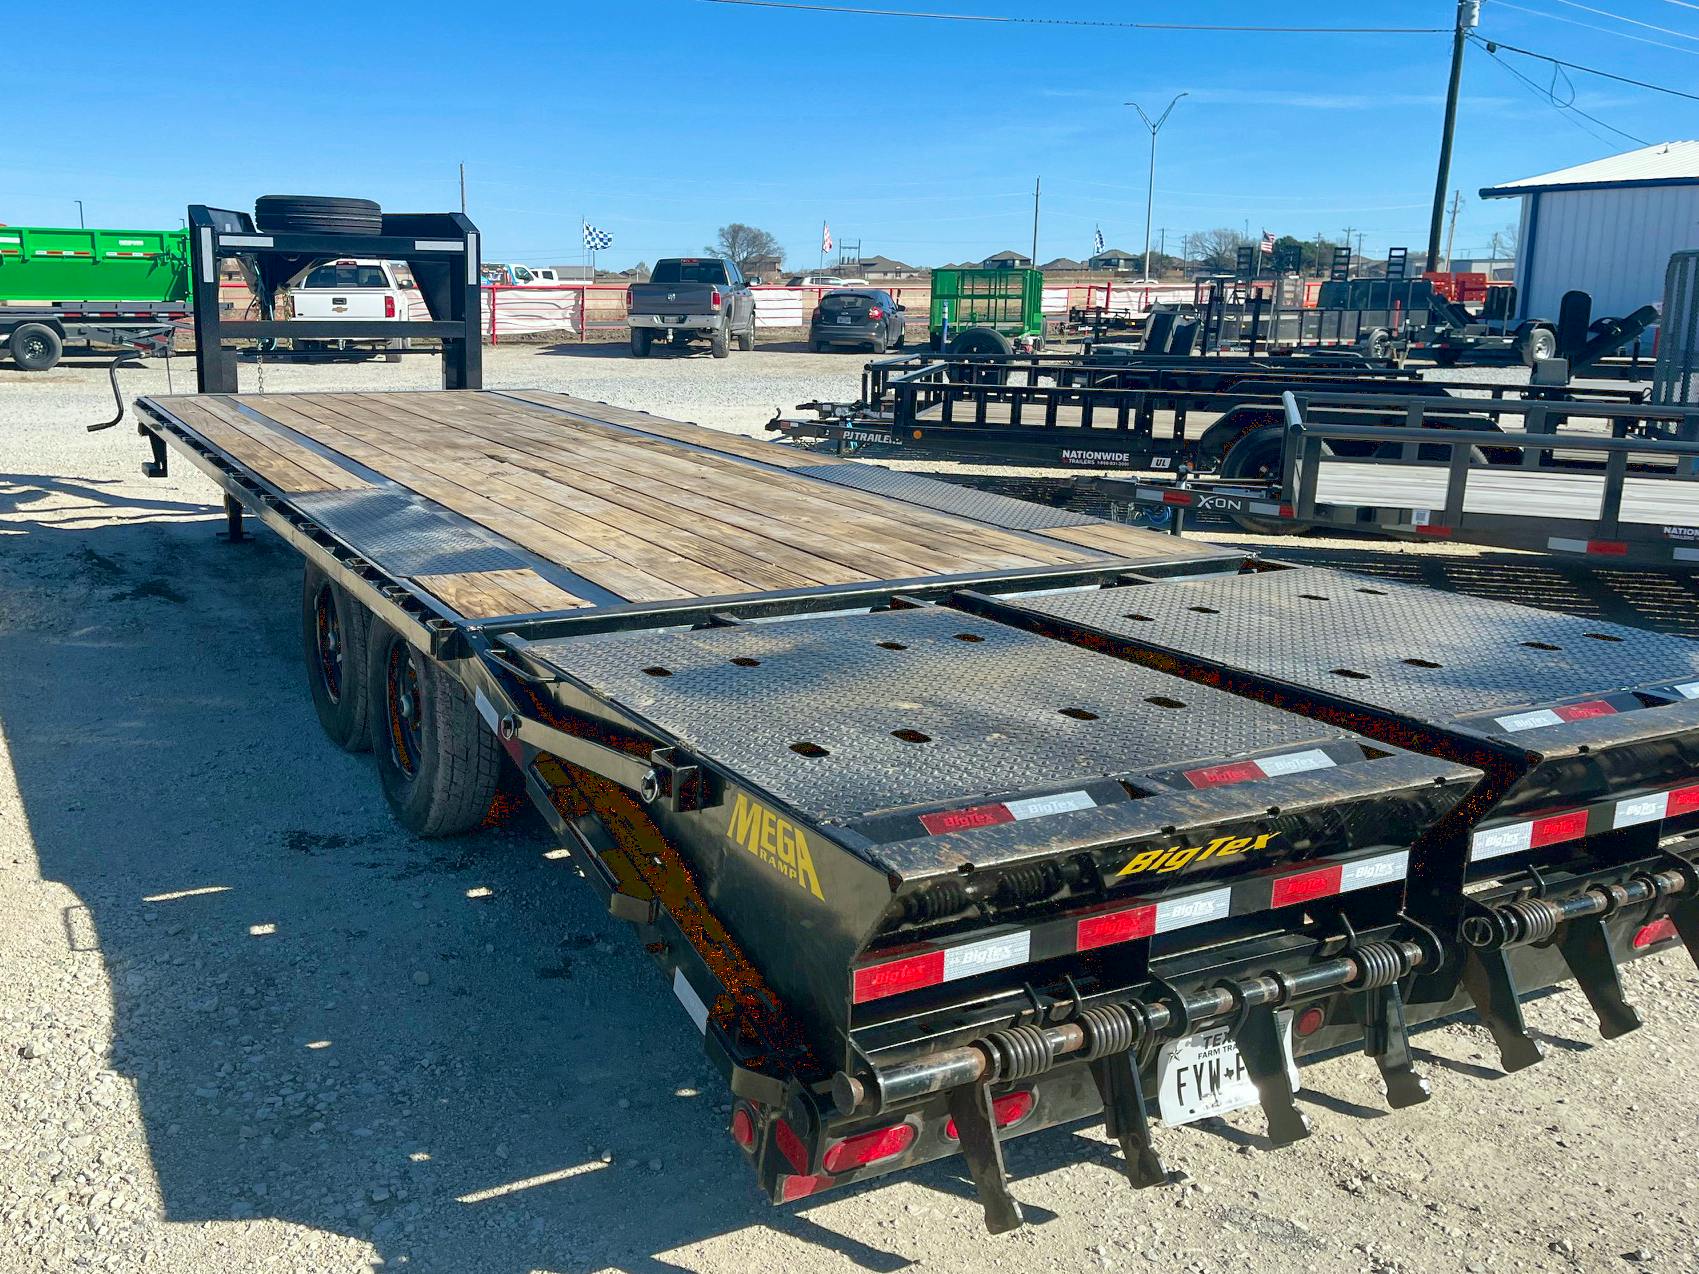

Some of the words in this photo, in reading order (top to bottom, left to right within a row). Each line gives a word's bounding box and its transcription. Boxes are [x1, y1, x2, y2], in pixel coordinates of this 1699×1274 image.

[854, 432, 903, 445] TRAILE
[1062, 450, 1130, 461] NATIONWIDE
[1197, 495, 1242, 510] X-ON
[726, 793, 826, 902] MEGA
[760, 848, 797, 879] RAMP
[1198, 1048, 1221, 1060] FARM
